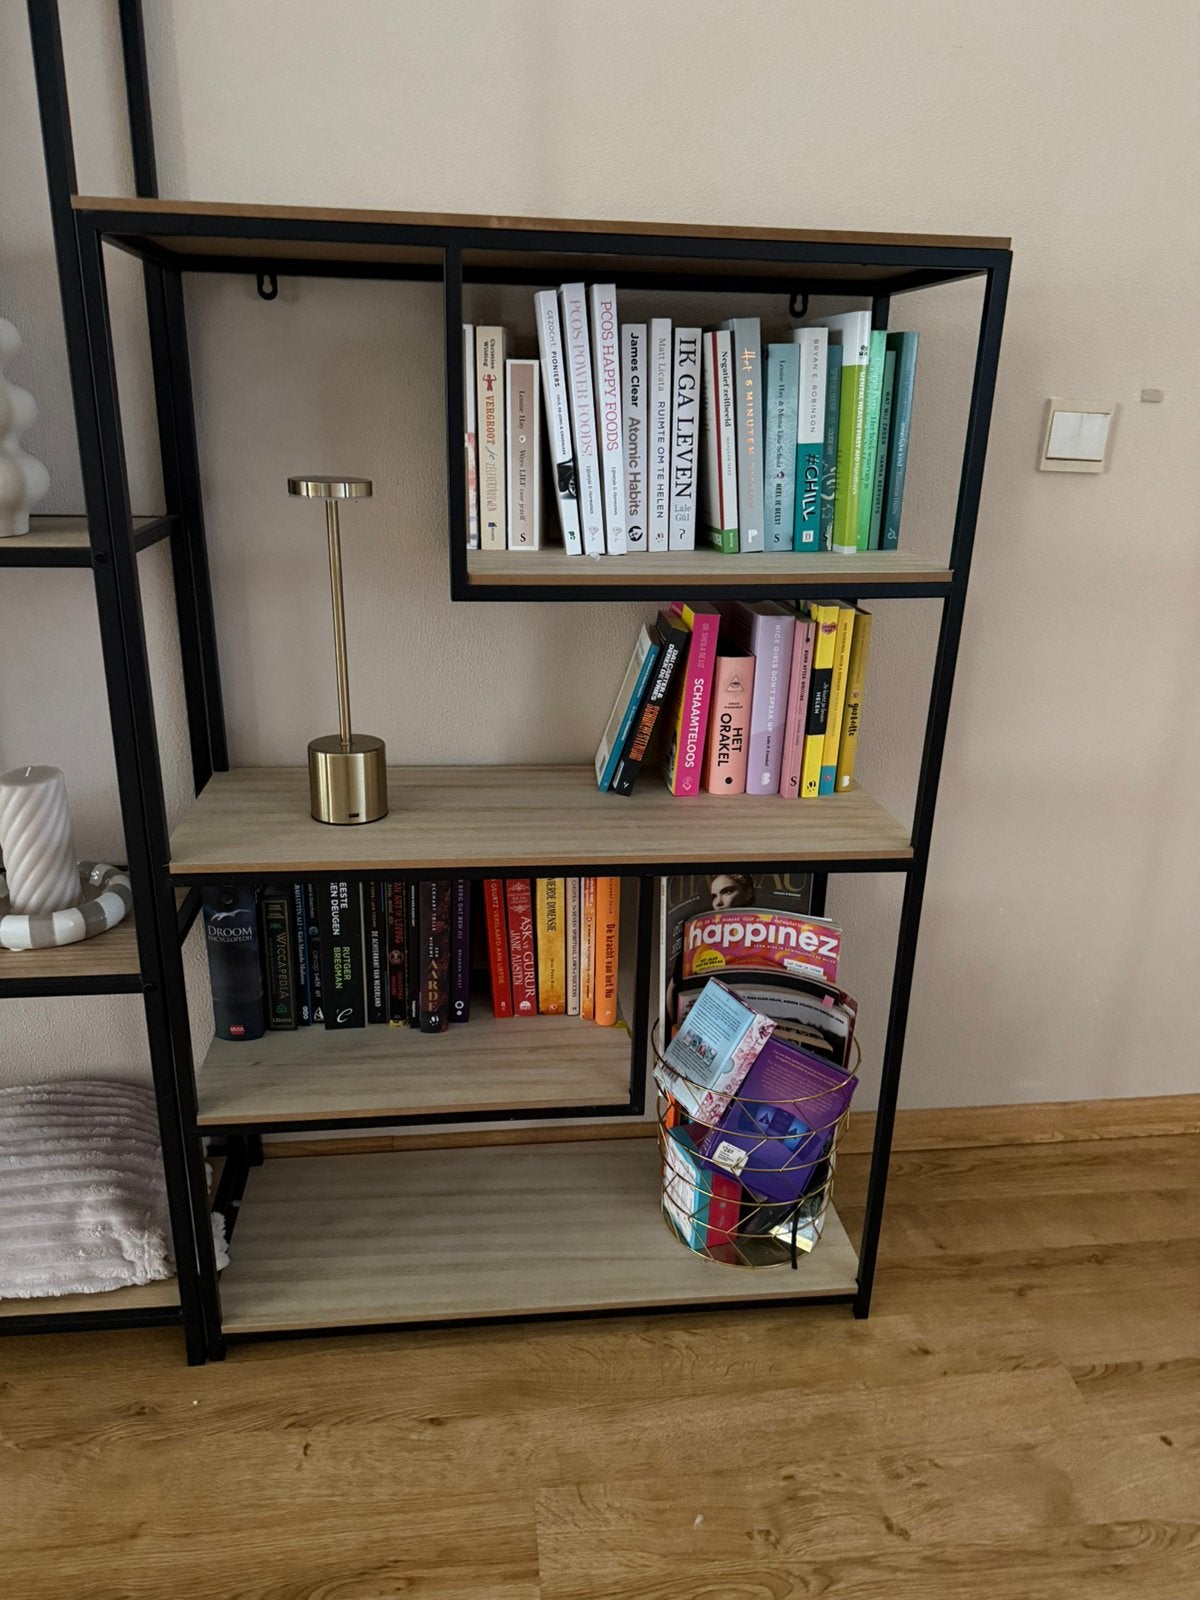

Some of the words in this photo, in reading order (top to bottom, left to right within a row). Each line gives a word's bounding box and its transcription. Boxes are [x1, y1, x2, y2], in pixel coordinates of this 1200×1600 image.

[570, 300, 585, 340] PCOS
[600, 300, 614, 340] PCOS
[482, 340, 490, 366] Wilding
[630, 332, 640, 372] James
[658, 338, 667, 360] Matt
[678, 337, 698, 368] IK
[811, 338, 819, 370] BRYAN
[550, 350, 560, 388] PIONIERS
[572, 344, 589, 398] POWER
[602, 344, 617, 398] HAPPY
[658, 362, 667, 392] Licata
[720, 350, 731, 387] Negatief
[778, 360, 786, 382] Louise
[630, 374, 640, 408] Clear
[678, 374, 696, 408] GA
[776, 384, 785, 399] Hay
[858, 371, 866, 400] MENTAL
[518, 390, 526, 414] Louise
[722, 388, 732, 428] zelfbeeld
[810, 384, 818, 433] ROBINSON
[856, 400, 864, 428] HEALTH
[486, 394, 496, 446] VERGROOT
[518, 414, 526, 430] Hay
[578, 404, 593, 456] FOODS!
[604, 402, 619, 452] FOODS
[657, 401, 666, 443] RUIMTE
[744, 392, 754, 456] MINUTEN
[628, 416, 641, 468] Atomic
[855, 428, 863, 448] FIRST
[518, 450, 526, 468] Wees
[657, 446, 665, 464] OM
[674, 416, 695, 499] LEVEN
[657, 468, 665, 480] TE
[802, 453, 820, 522] #CHILL
[629, 472, 641, 516] Habits
[656, 484, 665, 519] HELEN
[874, 480, 882, 514] BERVOETS
[774, 624, 782, 644] NICE
[660, 643, 675, 669] DEREK
[670, 649, 679, 664] DAI
[771, 646, 780, 668] GIRLS
[657, 668, 666, 680] DE
[658, 662, 674, 694] CARTER
[769, 670, 778, 695] DON'T
[650, 679, 663, 701] VRIES
[814, 691, 822, 714] HELEN
[767, 696, 776, 720] SPEAK
[684, 678, 705, 768] SCHAAMTELOOS
[766, 721, 774, 732] UP
[717, 712, 732, 767] ORAKEL
[731, 727, 744, 753] HET
[393, 894, 402, 909] ART
[490, 882, 499, 908] GEURTZ
[208, 925, 252, 937] DROOM
[330, 899, 340, 936] DEUGEN
[394, 918, 404, 944] LIVING
[492, 910, 502, 947] VERSLAAFD
[519, 916, 532, 940] AŞK
[546, 902, 557, 932] DIMENSIE
[606, 923, 616, 934] De
[371, 930, 379, 938] DE
[510, 930, 521, 951] JANE
[605, 935, 616, 959] kracht
[688, 922, 838, 958] happinez
[275, 932, 290, 1000] WICCAPEDIA
[333, 946, 343, 989] BREGMAN
[342, 946, 352, 981] RUTGER
[371, 938, 380, 969] ACHTERKANT
[495, 947, 504, 962] AAN
[605, 960, 614, 973] van
[497, 963, 505, 984] LIEFDE
[511, 953, 523, 986] AUSTEN
[522, 951, 536, 999] GURUR
[605, 975, 614, 988] het
[373, 980, 382, 1008] NEDERLAND
[604, 988, 614, 999] Nu
